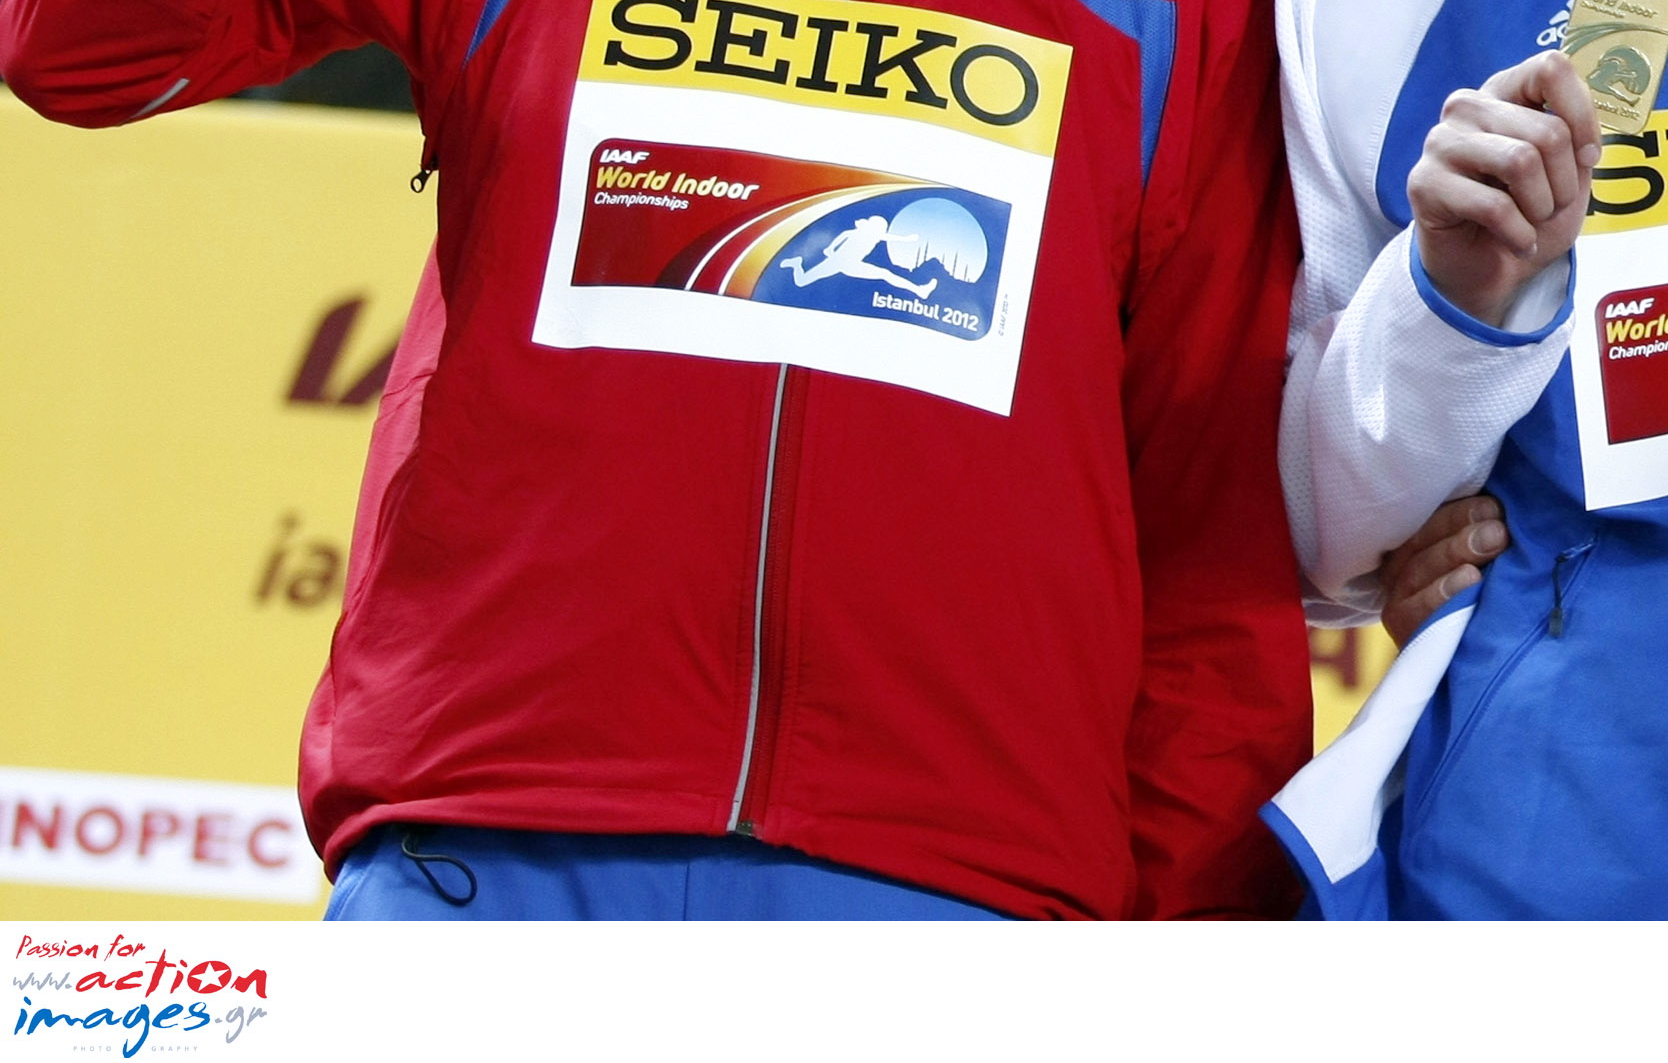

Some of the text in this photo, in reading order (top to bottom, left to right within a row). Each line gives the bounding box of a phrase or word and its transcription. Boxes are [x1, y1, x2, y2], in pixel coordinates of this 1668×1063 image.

[600, 149, 650, 164] IAAF
[596, 166, 759, 201] World Indoor
[594, 192, 689, 211] Championships
[872, 291, 979, 332] Istanbul 2012
[1605, 298, 1655, 318] IAAF
